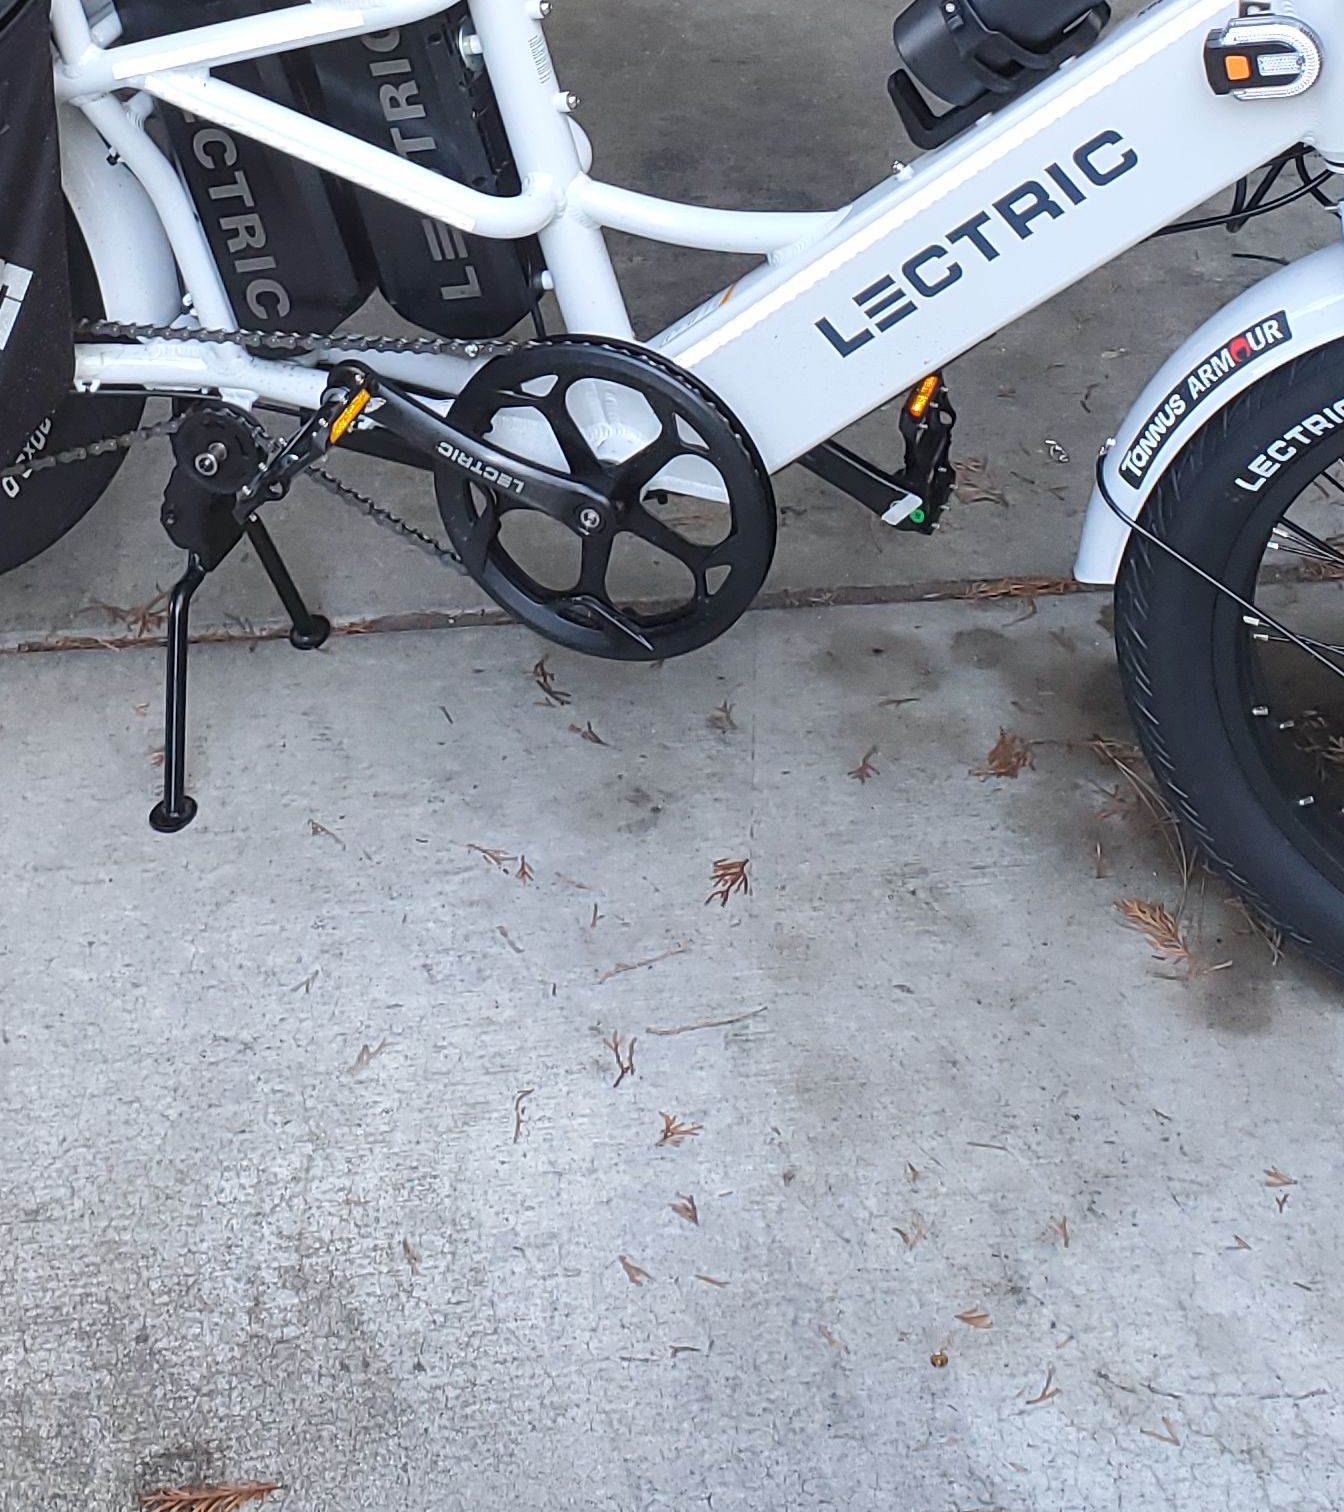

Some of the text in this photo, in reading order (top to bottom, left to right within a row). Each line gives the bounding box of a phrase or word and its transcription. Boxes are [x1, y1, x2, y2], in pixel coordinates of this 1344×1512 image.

[184, 111, 291, 320] CTRIC
[814, 130, 1138, 358] LECTRIC
[436, 441, 525, 494] LECTRIC
